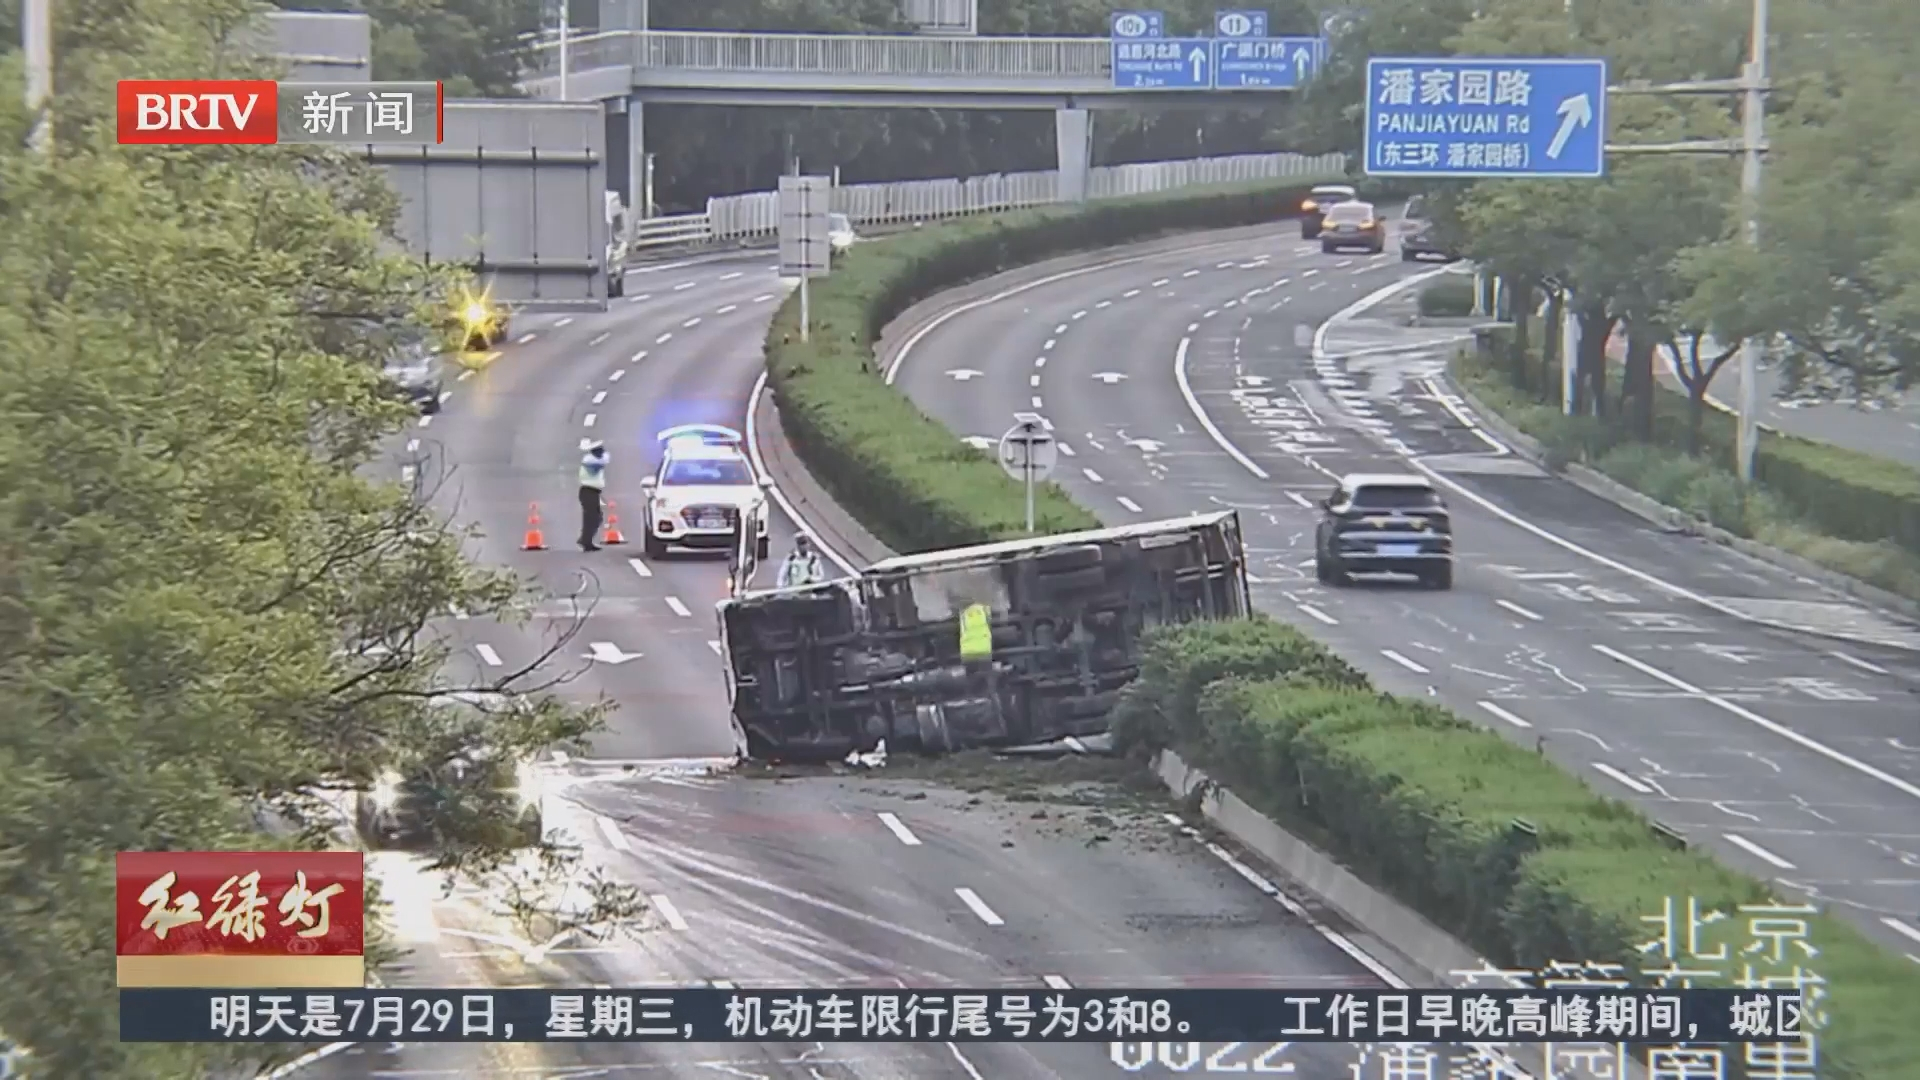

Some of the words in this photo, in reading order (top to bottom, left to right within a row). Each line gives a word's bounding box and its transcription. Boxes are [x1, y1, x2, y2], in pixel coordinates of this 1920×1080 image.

[1379, 68, 1532, 106] 潘家园路
[1377, 113, 1498, 133] PANJIAYUAN
[1506, 113, 1530, 133] Rd
